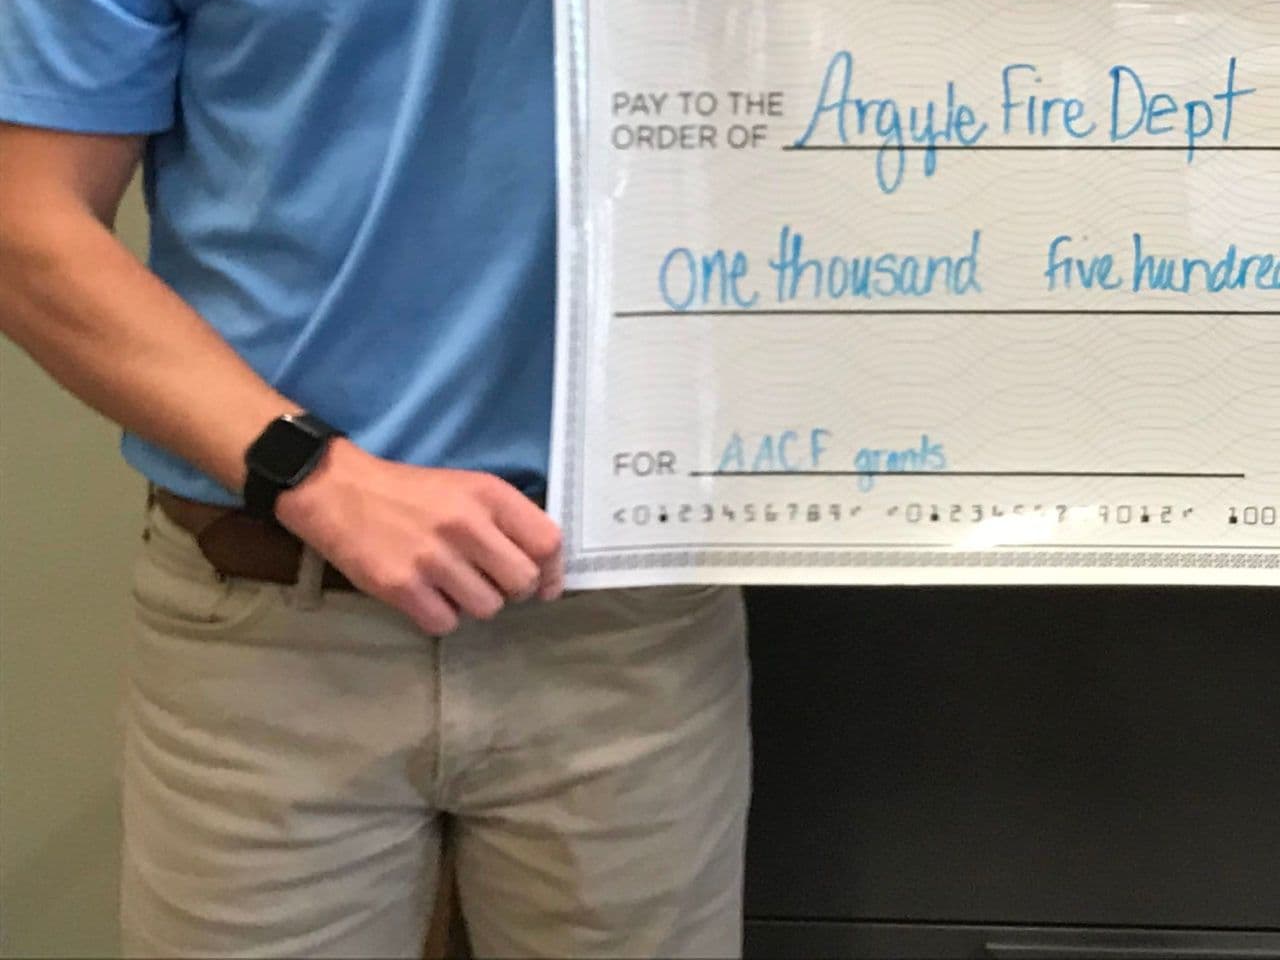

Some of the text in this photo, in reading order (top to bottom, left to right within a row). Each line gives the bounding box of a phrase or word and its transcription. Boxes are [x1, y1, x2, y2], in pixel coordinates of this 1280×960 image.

[611, 91, 784, 117] PAY TO THE
[794, 50, 1257, 194] Argyle Fire Dept
[611, 123, 768, 150] ORDER OF
[768, 224, 983, 305] thousand
[1044, 234, 1124, 293] five
[613, 450, 678, 478] FOR
